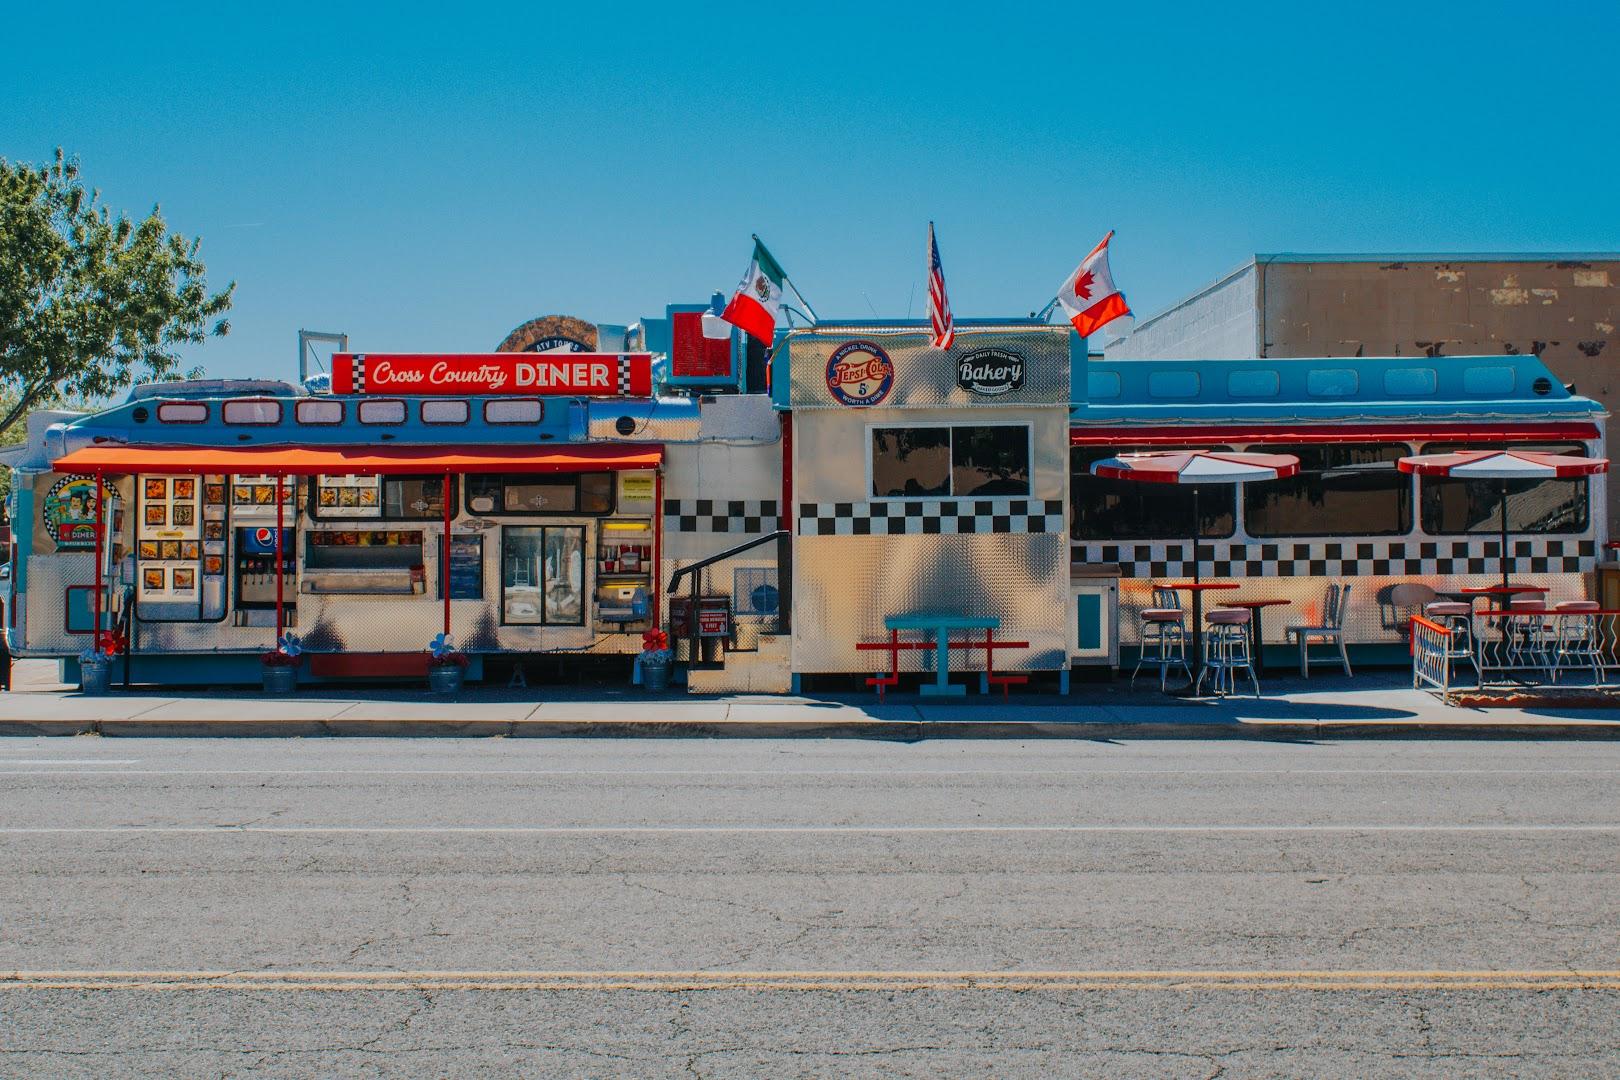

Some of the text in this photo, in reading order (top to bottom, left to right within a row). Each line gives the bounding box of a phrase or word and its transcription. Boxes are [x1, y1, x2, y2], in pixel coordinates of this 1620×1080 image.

[536, 340, 550, 352] ATV
[975, 351, 1008, 359] DAILY FRESH
[372, 361, 610, 389] Cross Country DINER
[959, 363, 1023, 382] Bakery
[842, 394, 864, 405] WORTH
